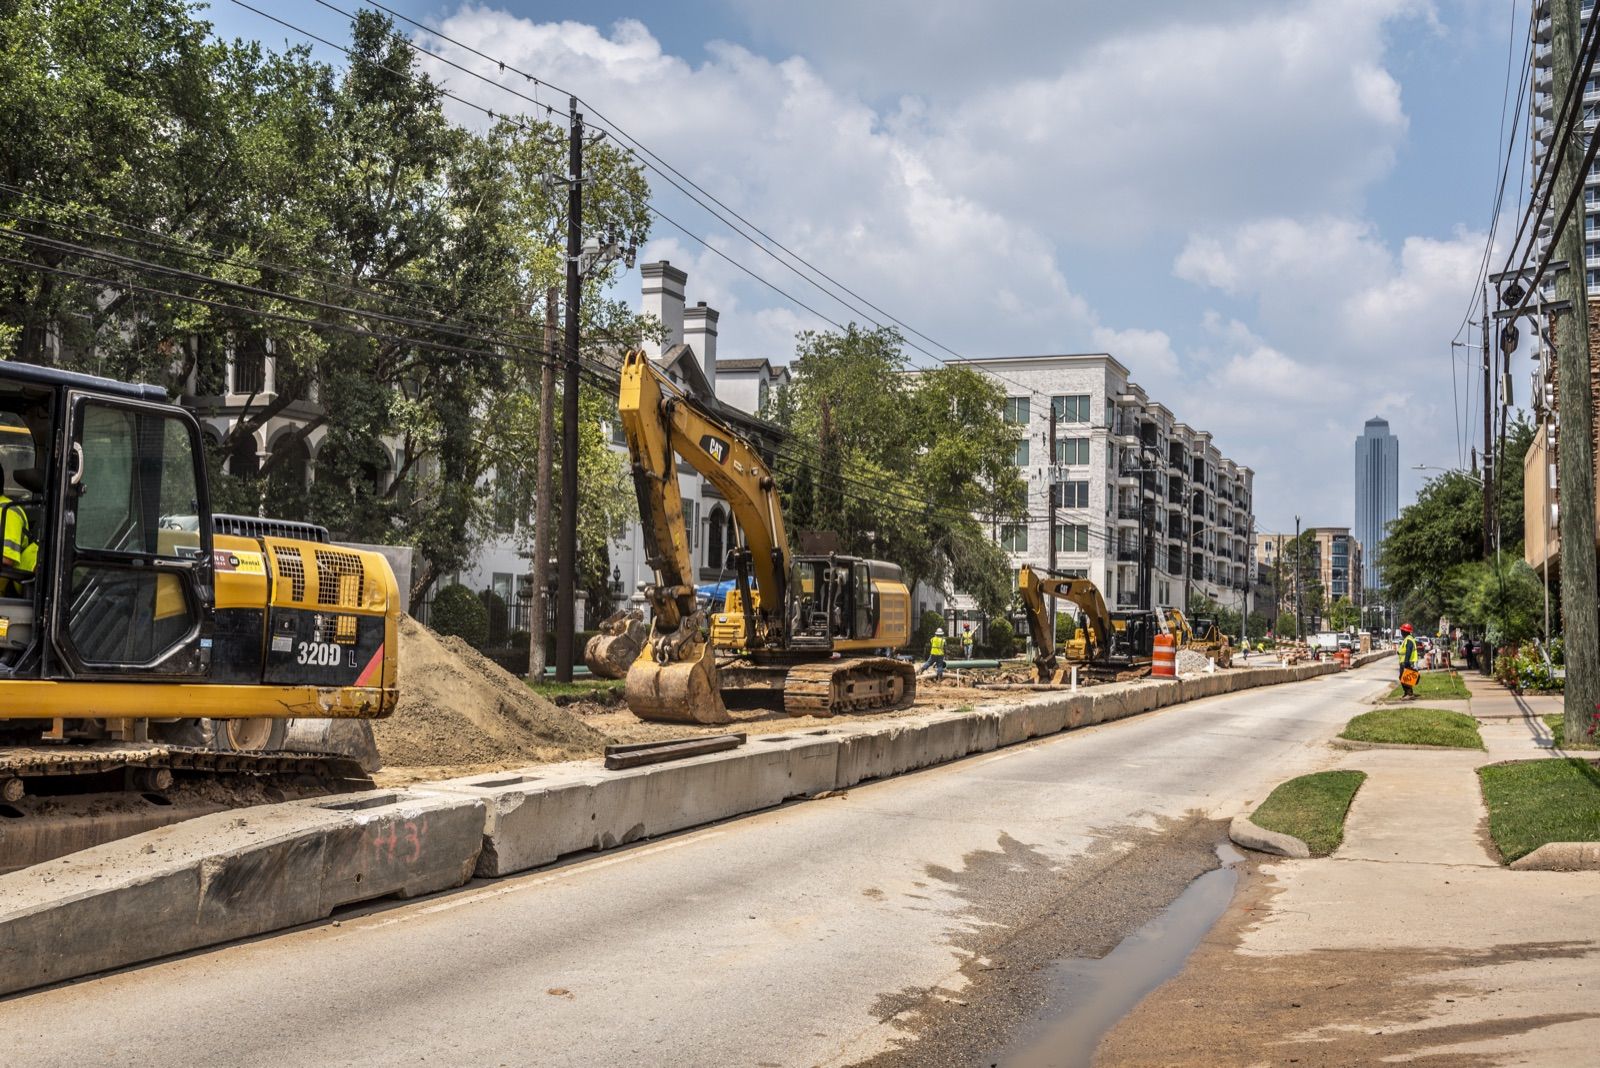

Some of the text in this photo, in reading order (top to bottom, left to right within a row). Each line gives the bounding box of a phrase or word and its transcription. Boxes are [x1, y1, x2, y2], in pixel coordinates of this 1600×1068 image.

[710, 438, 723, 462] CAT
[297, 641, 341, 666] 320D
[348, 649, 358, 668] L
